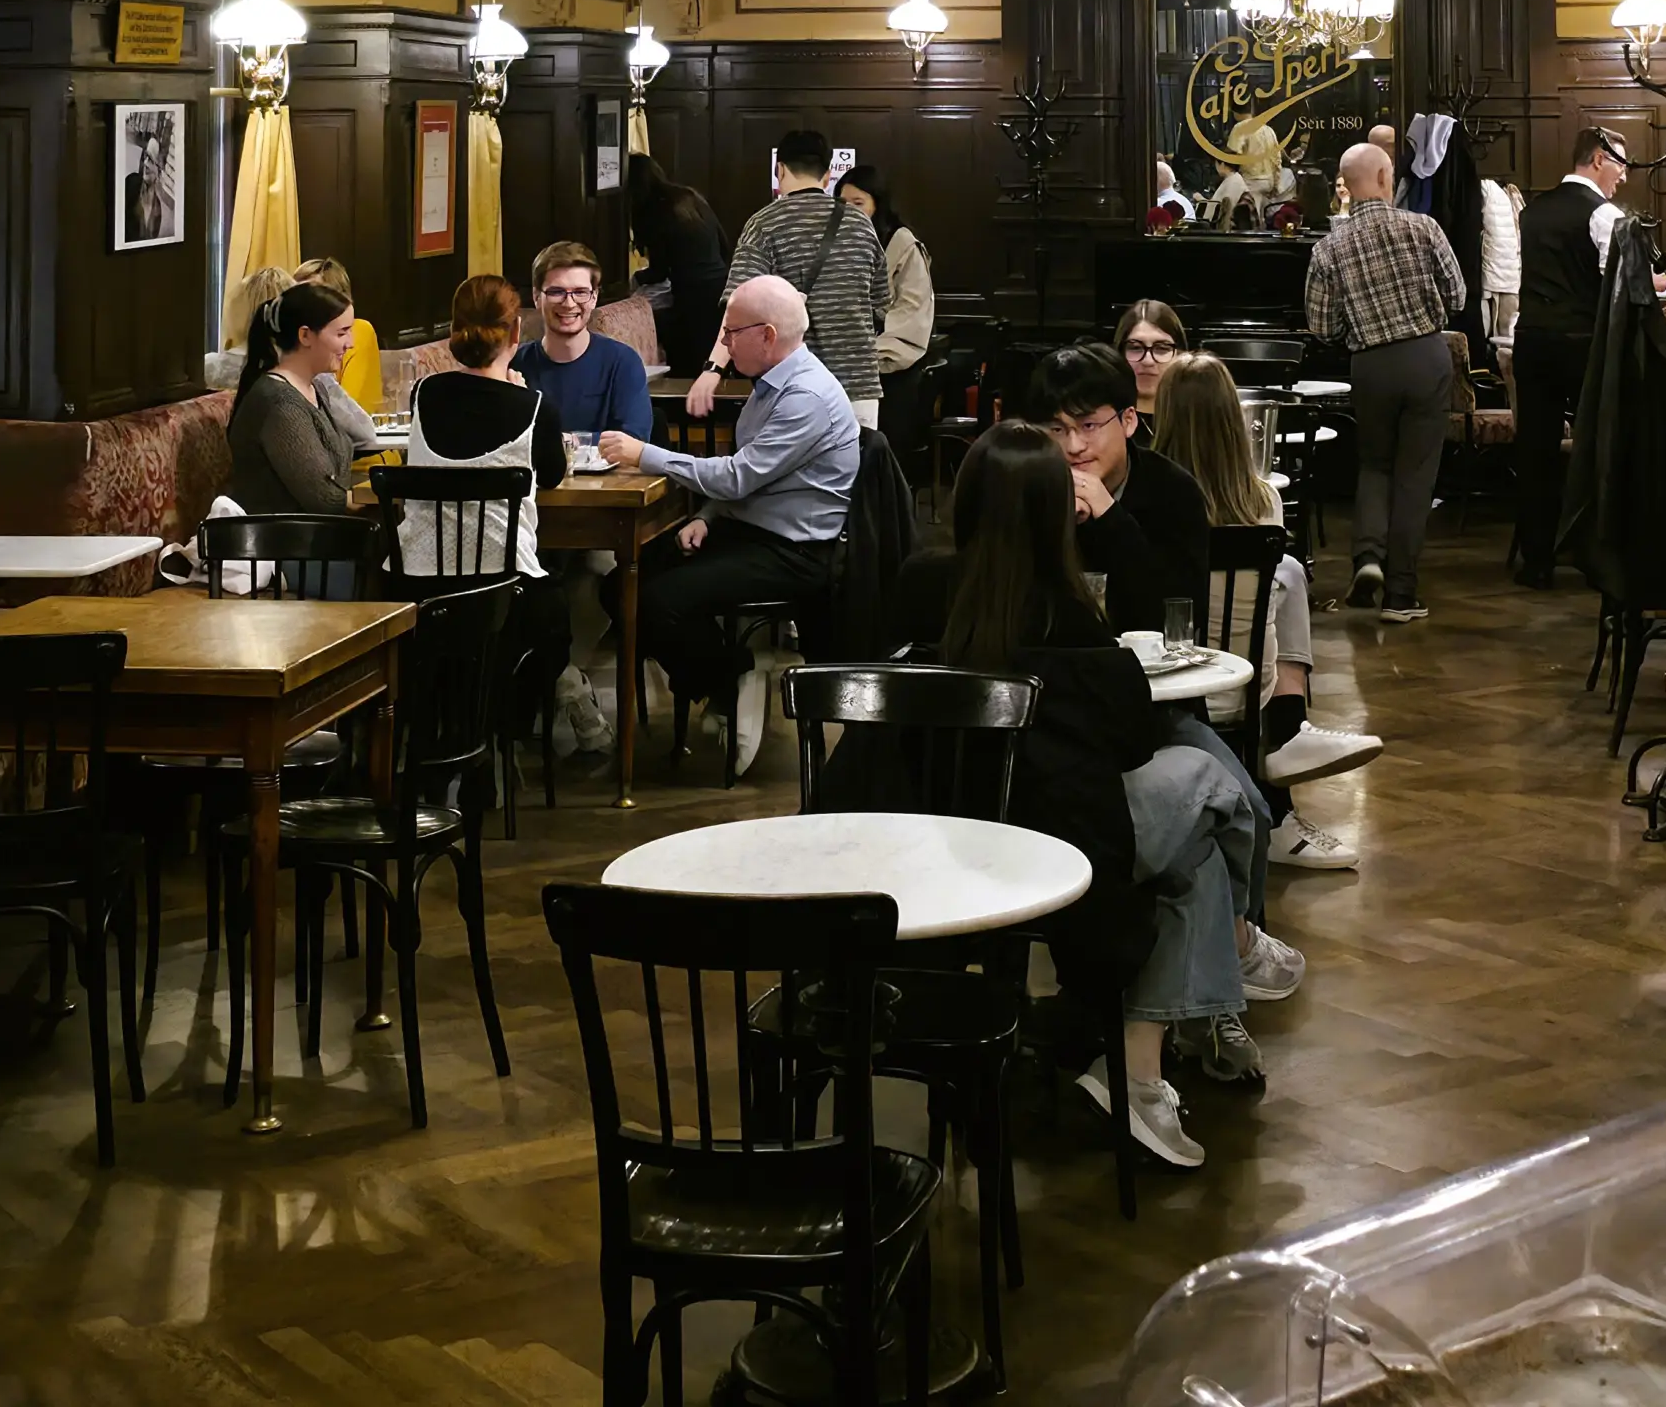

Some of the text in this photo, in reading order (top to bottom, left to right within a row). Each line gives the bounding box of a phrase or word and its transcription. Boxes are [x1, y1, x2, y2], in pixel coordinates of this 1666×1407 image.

[1253, 39, 1358, 98] Sperl
[1298, 116, 1363, 130] Seit 1880
